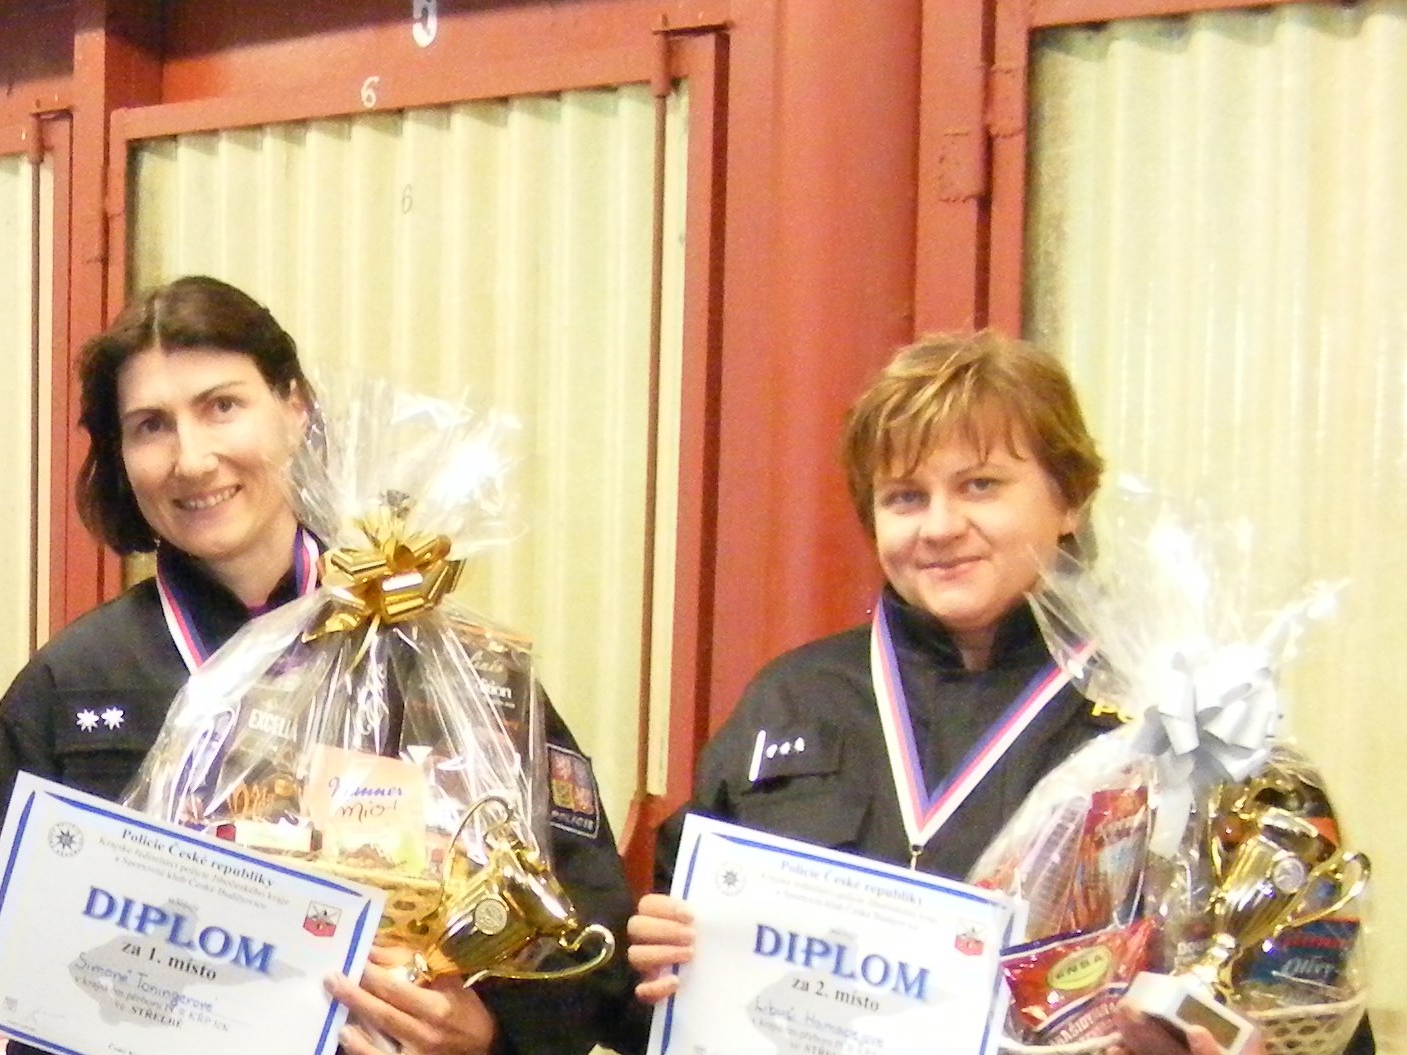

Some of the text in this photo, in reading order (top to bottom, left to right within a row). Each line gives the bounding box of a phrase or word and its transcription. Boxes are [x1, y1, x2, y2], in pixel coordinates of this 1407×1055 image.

[360, 76, 381, 109] 6
[121, 828, 274, 887] Policie České republiky
[81, 886, 278, 975] DIPLOM
[120, 942, 217, 982] za 1. místo
[752, 923, 933, 1002] DIPLOM
[792, 978, 880, 1012] za 2. místo
